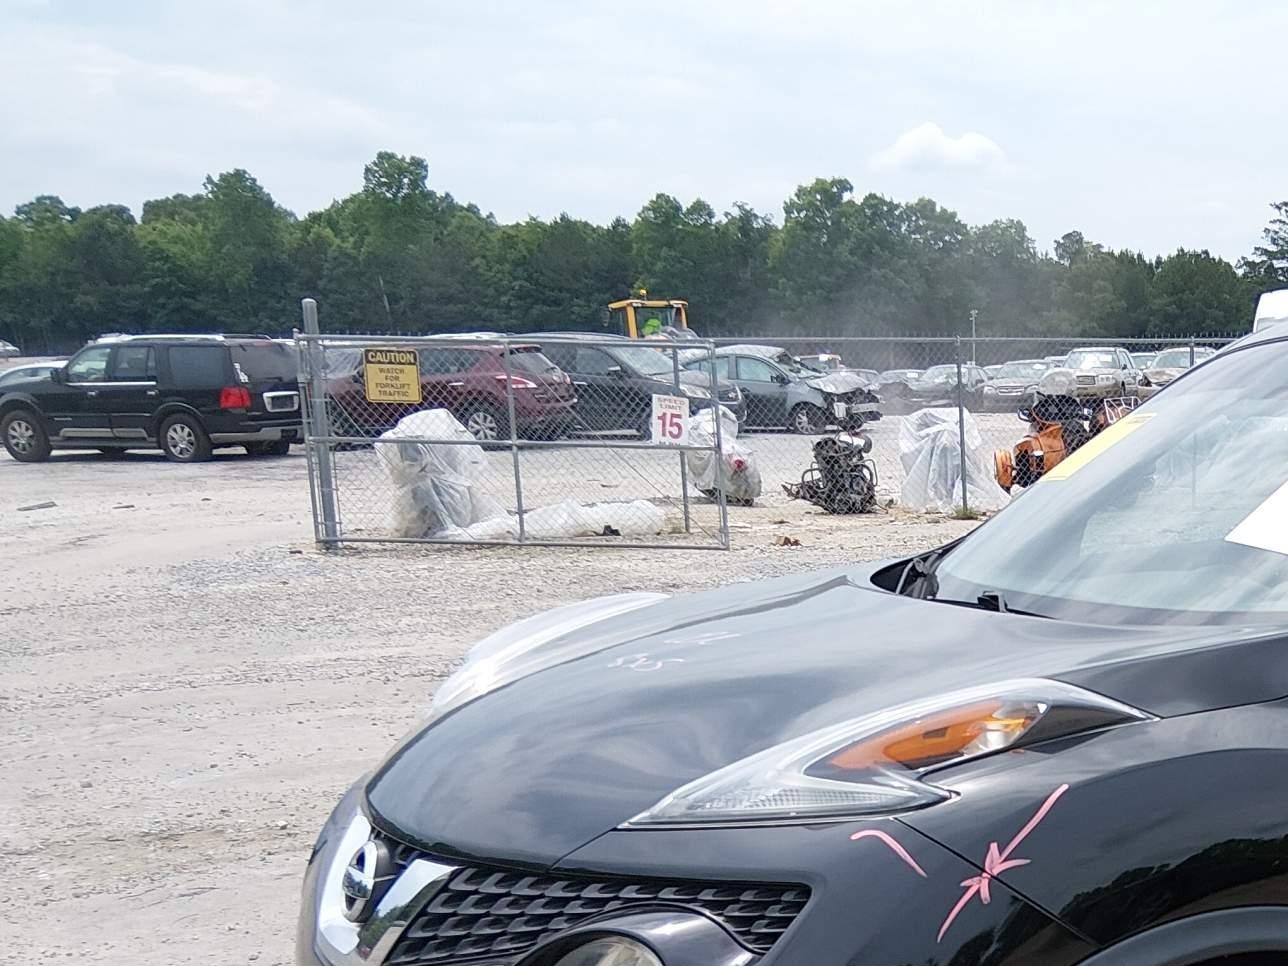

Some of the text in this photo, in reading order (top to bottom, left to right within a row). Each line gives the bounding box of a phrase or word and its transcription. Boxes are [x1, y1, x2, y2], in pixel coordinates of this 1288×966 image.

[368, 351, 415, 363] CAUTION
[375, 382, 411, 390] FORKLIFT
[378, 390, 409, 398] TRAFFIC
[657, 397, 685, 406] SPEED
[657, 412, 683, 439] 15
